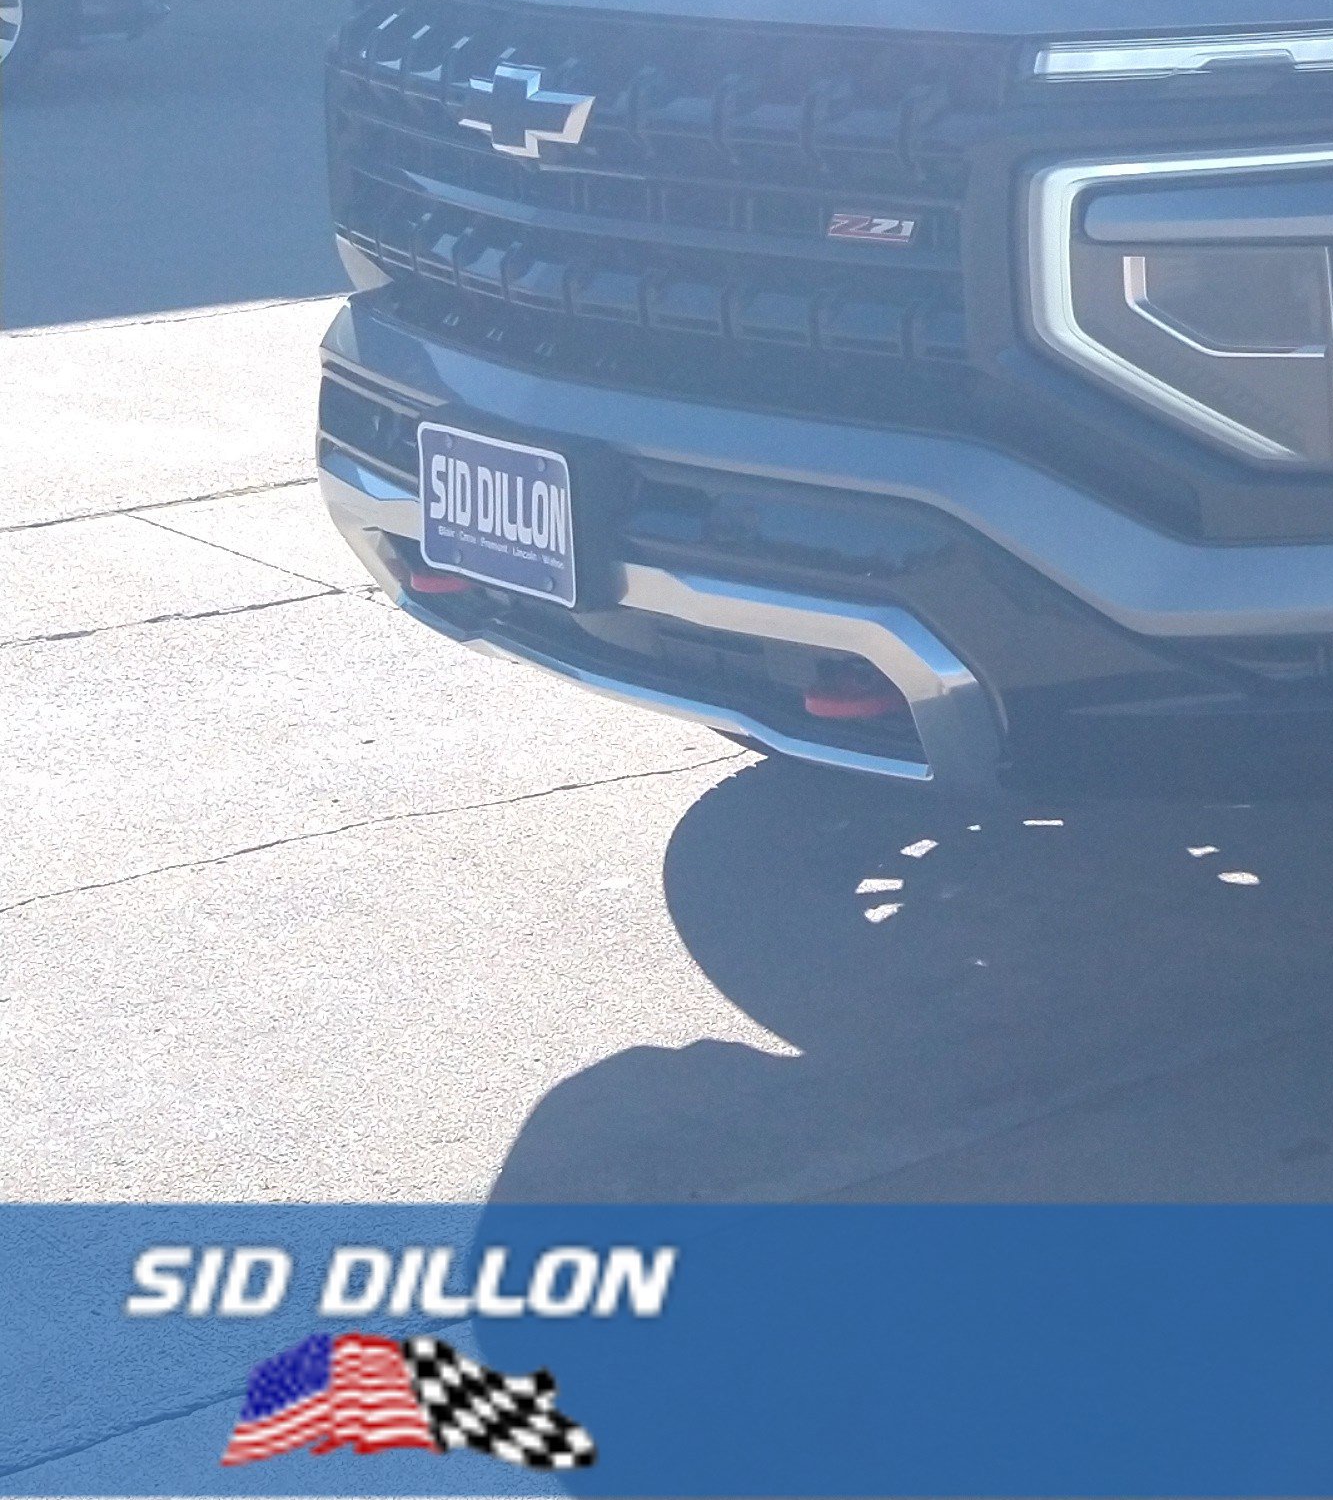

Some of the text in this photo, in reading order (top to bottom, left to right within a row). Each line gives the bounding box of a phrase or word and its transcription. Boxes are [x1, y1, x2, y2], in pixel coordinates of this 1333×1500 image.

[827, 213, 915, 243] Z71
[430, 454, 566, 556] SID DILLON
